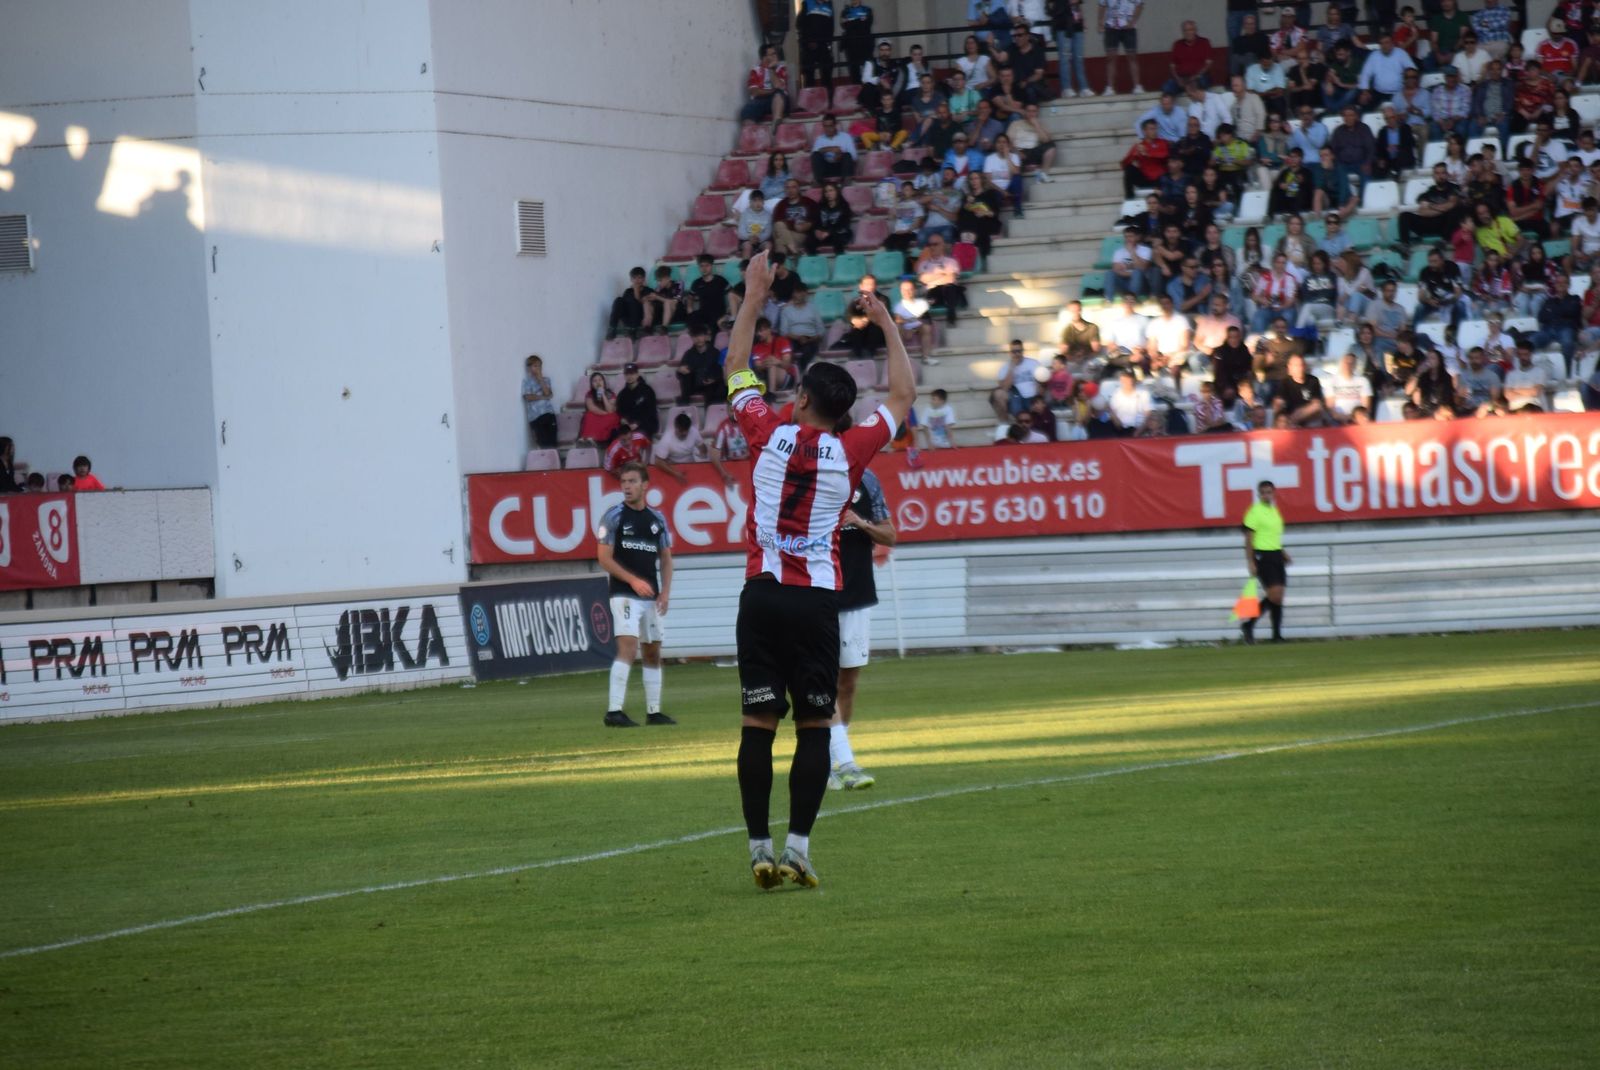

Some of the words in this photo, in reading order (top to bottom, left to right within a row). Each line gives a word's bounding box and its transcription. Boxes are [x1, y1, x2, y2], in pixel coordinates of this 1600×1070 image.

[898, 458, 1101, 490] www.cubiex.es
[49, 509, 62, 551] 8
[488, 476, 748, 555] cubex
[935, 500, 986, 526] 675
[994, 496, 1046, 522] 630
[1054, 493, 1105, 519] 110
[32, 530, 57, 579] ZAMORA
[128, 628, 203, 673] PRM
[221, 622, 291, 666] PRM
[494, 598, 589, 659] IMPULSO23
[28, 635, 107, 682] PRM
